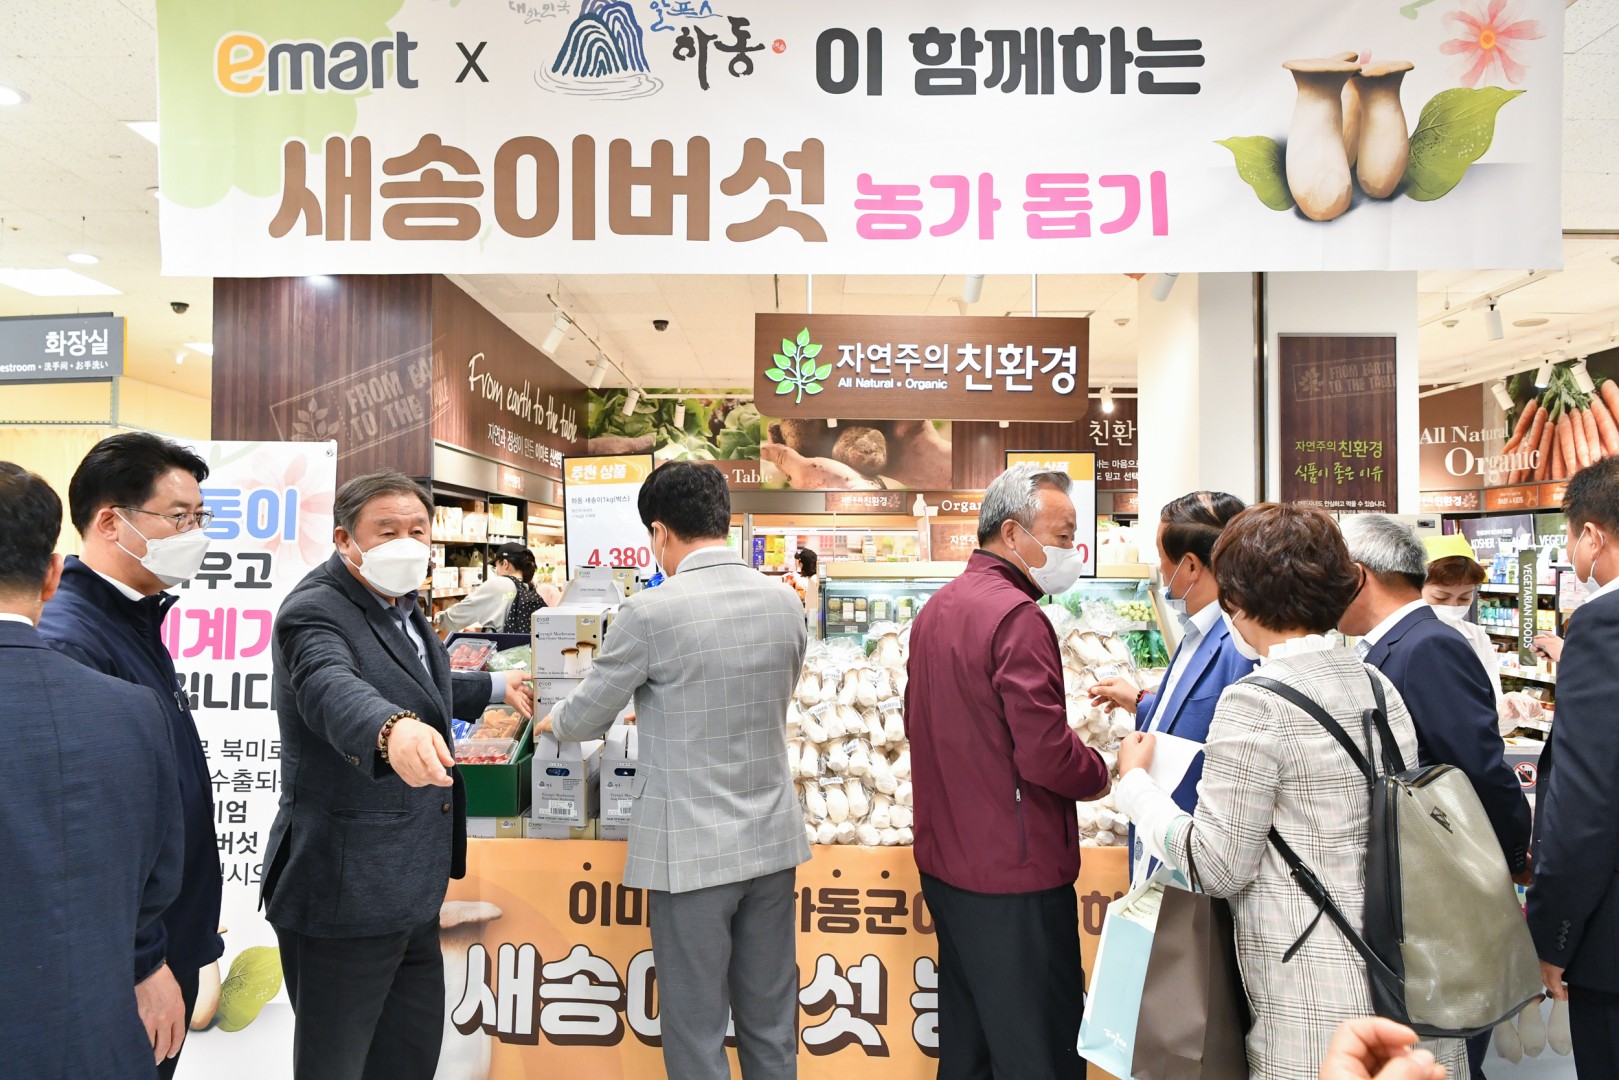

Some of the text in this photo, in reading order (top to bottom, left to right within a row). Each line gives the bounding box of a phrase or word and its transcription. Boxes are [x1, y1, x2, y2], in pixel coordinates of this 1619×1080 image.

[215, 31, 419, 94] emart
[672, 16, 766, 91] 하동
[815, 26, 1206, 96] 이 함께하는
[268, 133, 1170, 243] 새송이버섯 농가 돕기
[44, 329, 109, 356] 화장실
[0, 363, 37, 373] estroom
[836, 342, 1078, 394] 자연주의 친환경
[837, 377, 948, 390] All Natural Organic
[345, 369, 405, 415] FROM
[468, 352, 578, 444] From earth to the table
[1089, 420, 1137, 446] 친환
[1419, 420, 1510, 445] All Natural
[1295, 440, 1384, 459] 자연주의 친환경
[1444, 442, 1540, 483] Organic
[732, 469, 773, 484] Table
[1294, 462, 1384, 485] 식품이 좋은 이유
[201, 488, 297, 541] 동이
[950, 535, 977, 546] 자연주
[1539, 534, 1568, 548] VEGETA
[181, 552, 272, 589] 우고
[1523, 563, 1533, 649] VEGETARIAN FOODS
[211, 769, 281, 792] 수출되
